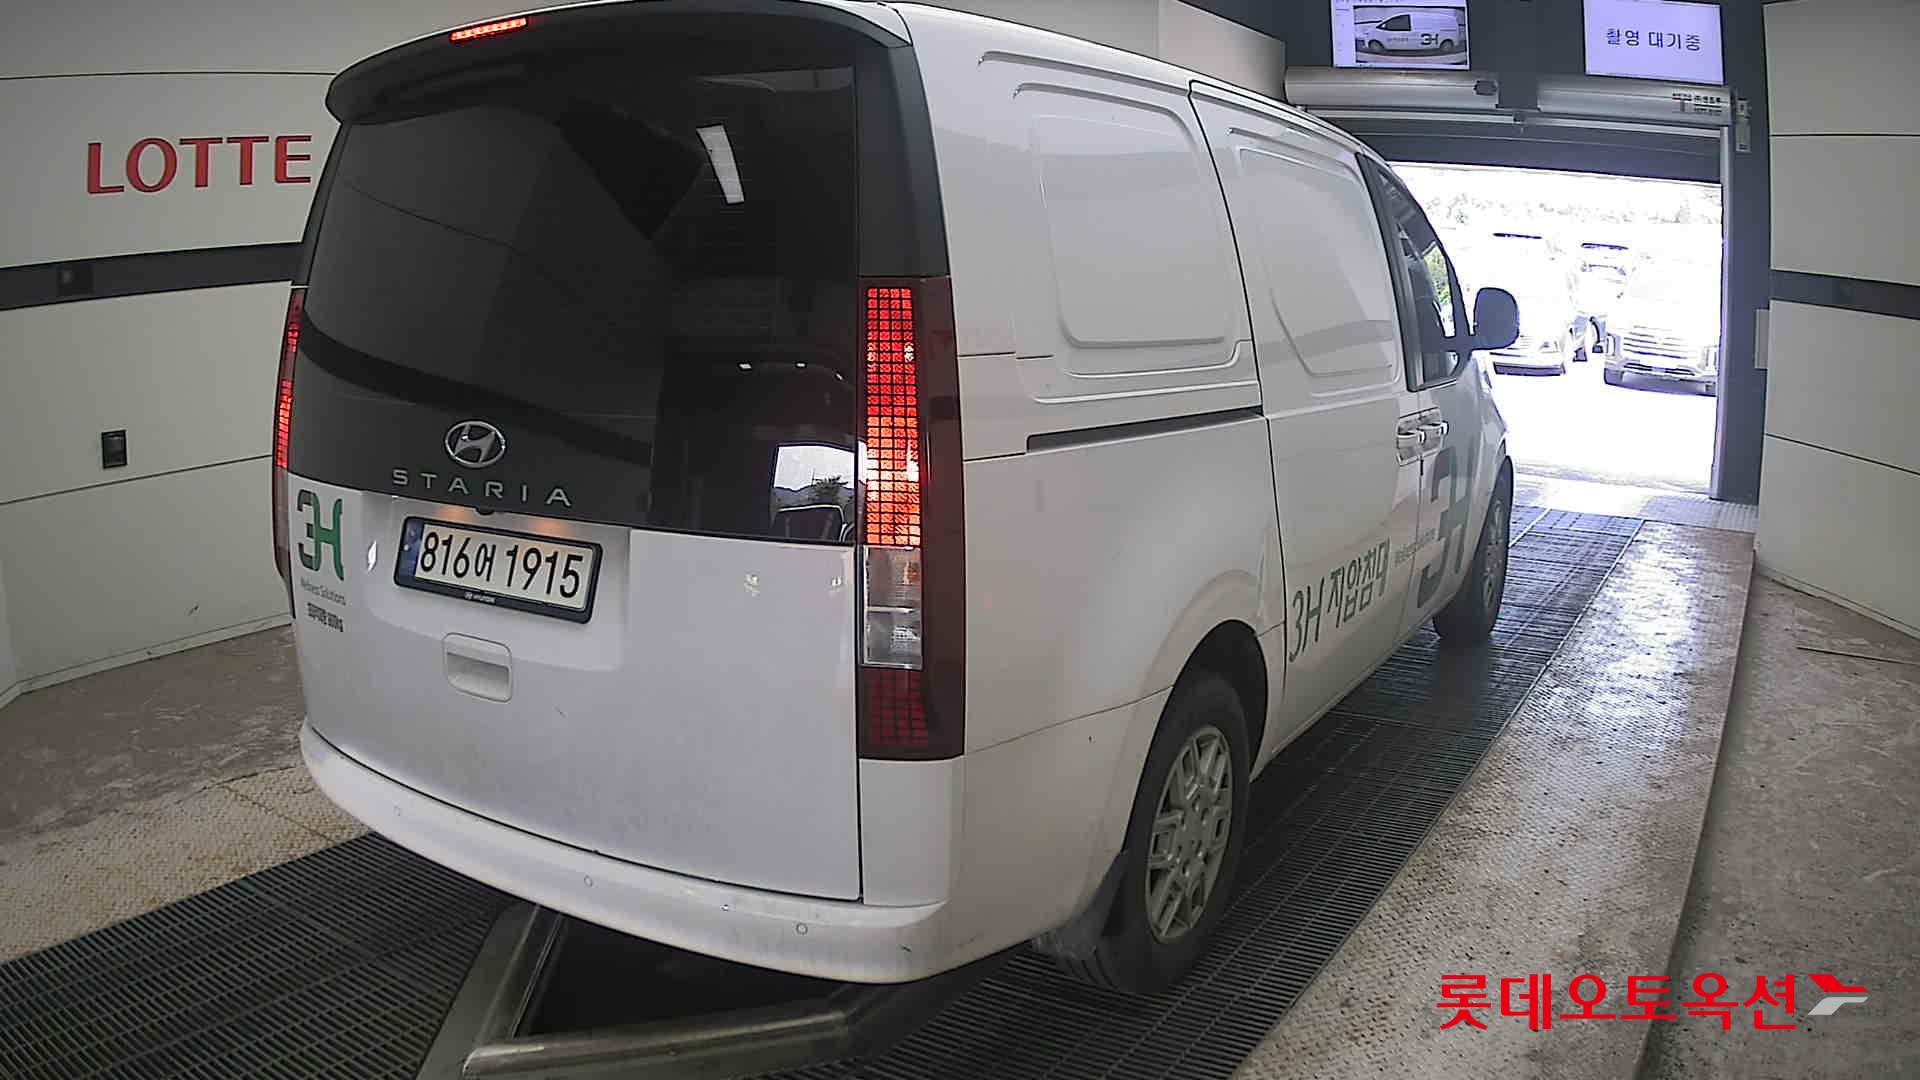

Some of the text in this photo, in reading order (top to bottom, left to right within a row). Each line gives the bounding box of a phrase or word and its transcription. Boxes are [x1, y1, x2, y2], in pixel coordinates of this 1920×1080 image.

[1648, 31, 1701, 51] 대기중
[87, 135, 312, 194] LOTTE
[392, 468, 572, 507] STARIA
[419, 531, 584, 598] 816어 1915
[1289, 576, 1325, 663] 3H
